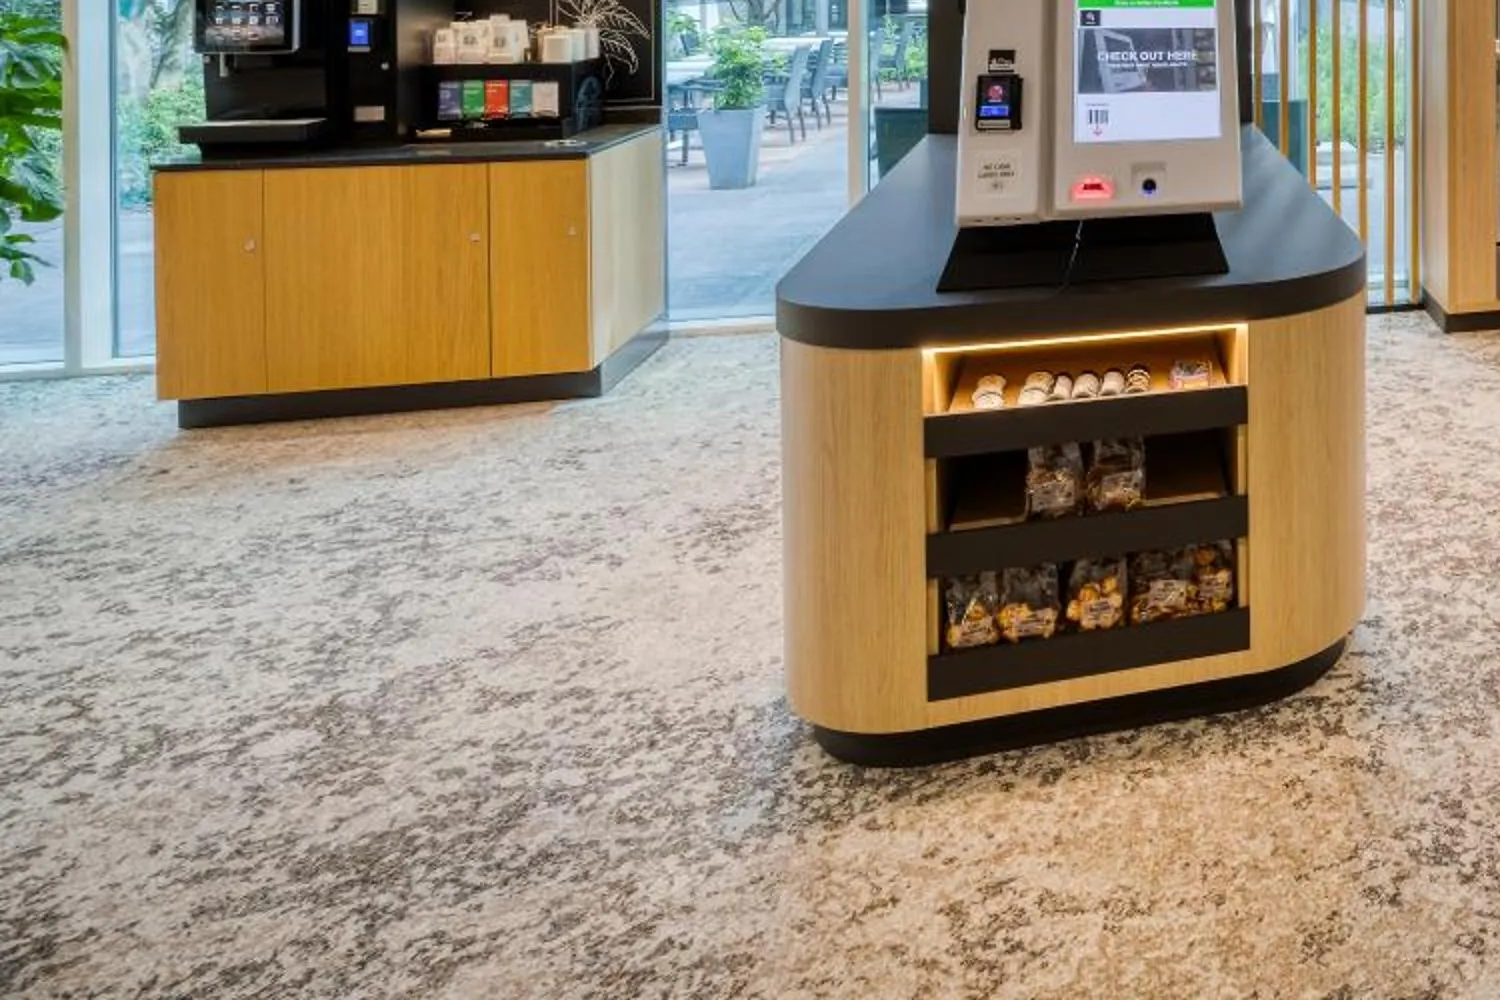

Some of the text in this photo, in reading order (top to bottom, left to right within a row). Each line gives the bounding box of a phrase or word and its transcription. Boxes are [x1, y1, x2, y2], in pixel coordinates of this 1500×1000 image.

[1098, 51, 1198, 61] CHECK OUT HERE
